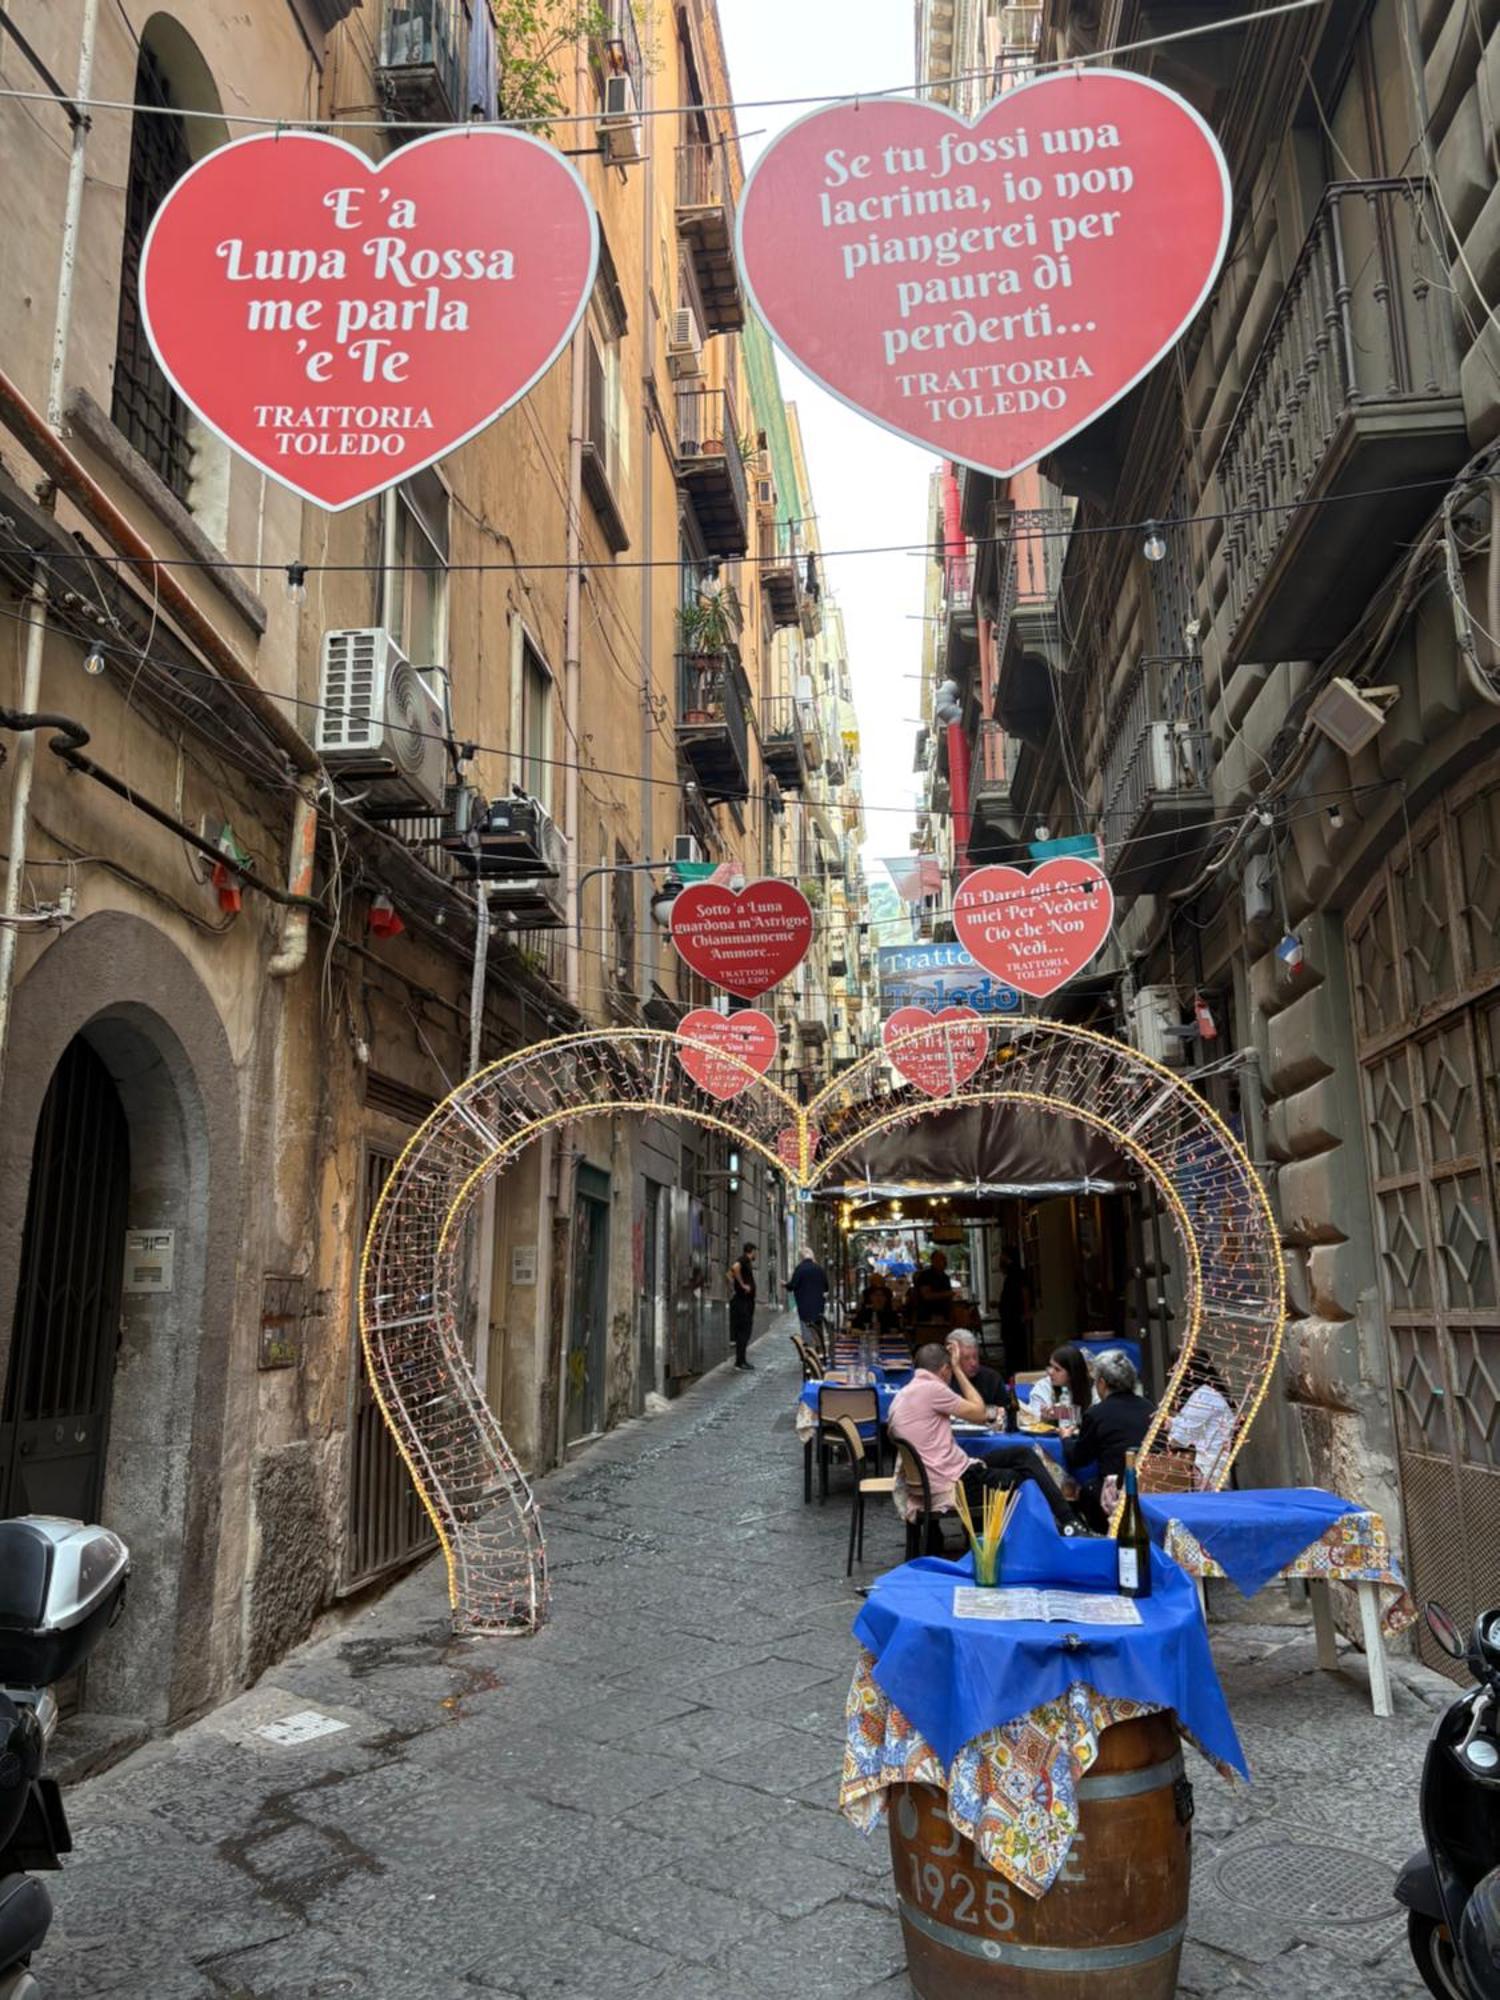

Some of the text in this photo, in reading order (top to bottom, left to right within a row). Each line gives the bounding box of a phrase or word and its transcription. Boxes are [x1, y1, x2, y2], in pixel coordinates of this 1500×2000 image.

[823, 123, 1120, 187] Se tu fossi una
[323, 188, 365, 229] E
[820, 163, 1134, 227] lacrima, io non
[841, 209, 1121, 279] piangerei per
[216, 236, 515, 287] Luna Rossa
[896, 254, 1072, 316] paura di
[247, 286, 469, 344] me parla
[881, 303, 1096, 366] perderti...
[348, 338, 409, 383] Te
[895, 355, 1095, 397] TRATTORIA
[254, 406, 434, 428] TRATTORIA
[925, 387, 1067, 422] TOLEDO
[275, 433, 405, 455] TOLEDO
[696, 904, 731, 917] Sotto
[747, 901, 782, 914] Luna
[959, 892, 975, 907] Ti
[979, 886, 1025, 903] Darei
[1030, 883, 1050, 902] gli
[967, 899, 1098, 925] miei Per Vedere
[984, 919, 1084, 943] Ciò che Non
[884, 948, 976, 973] Tratto
[1007, 957, 1070, 972] TRATTORIA
[1008, 941, 1064, 957] Vedi...
[720, 968, 777, 978] TRATTORIA
[1016, 968, 1061, 980] TOLEDO
[884, 977, 1018, 1010] Toledo
[910, 1853, 1015, 1930] 1925
